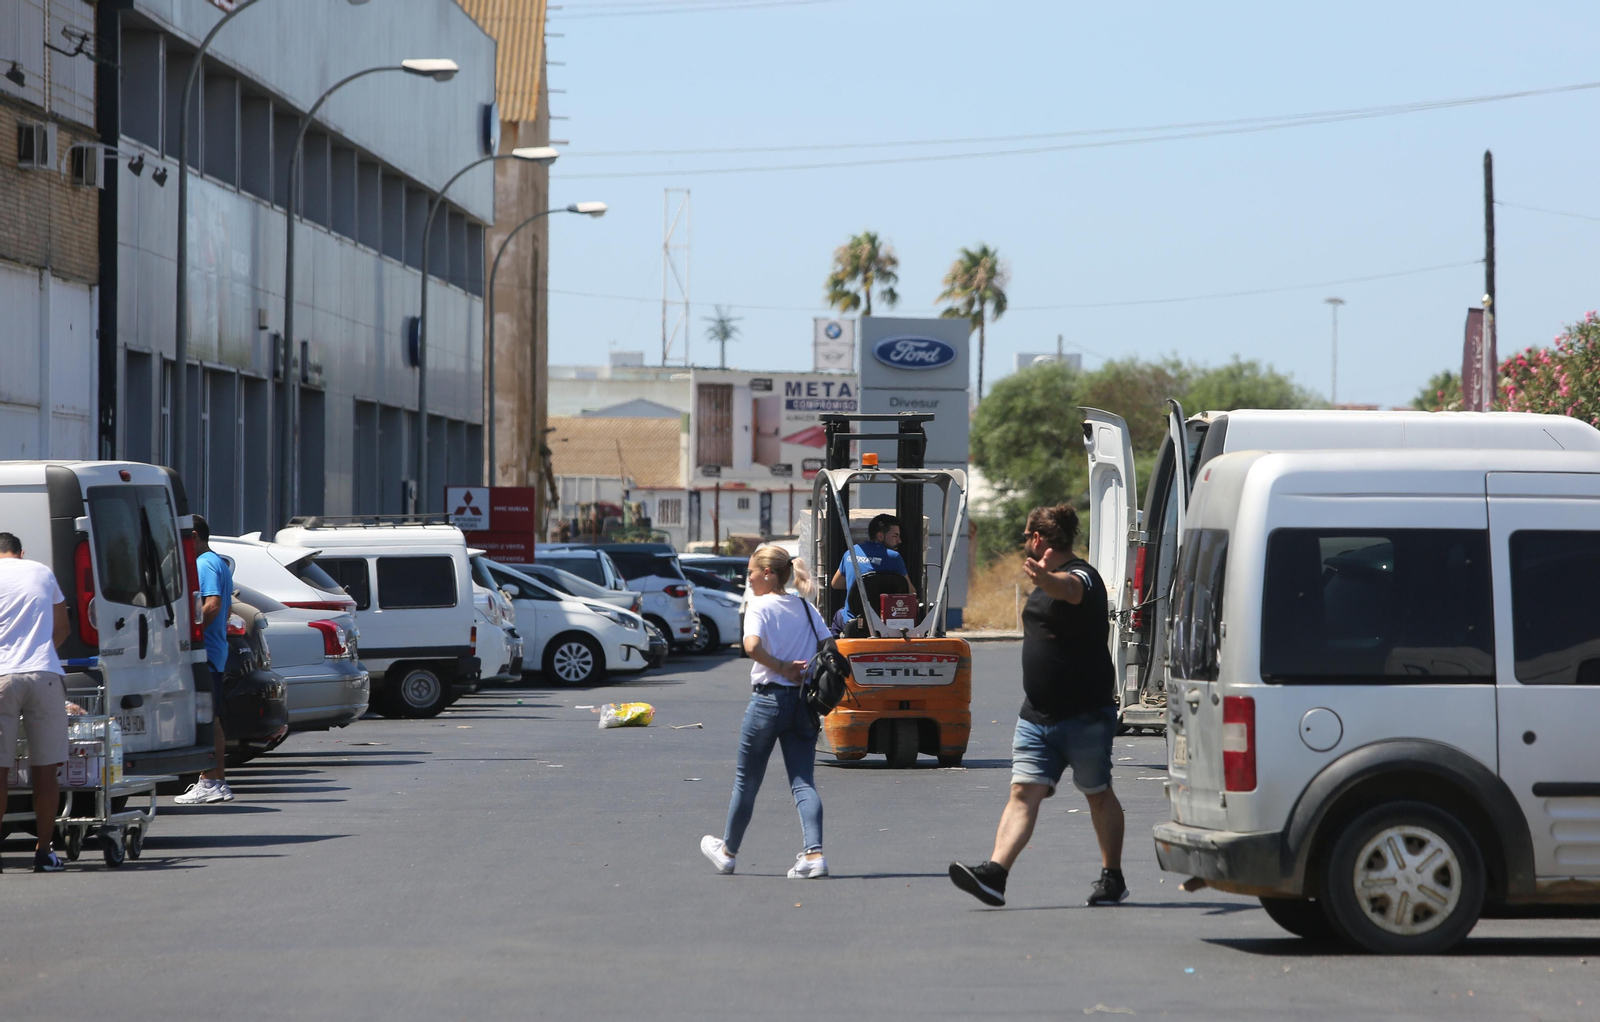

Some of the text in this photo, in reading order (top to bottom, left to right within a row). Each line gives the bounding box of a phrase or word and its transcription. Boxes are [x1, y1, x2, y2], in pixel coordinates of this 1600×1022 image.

[890, 340, 941, 363] Ford
[785, 381, 857, 397] META
[889, 397, 939, 409] Divesur
[506, 542, 525, 550] venta
[865, 668, 943, 677] STILL
